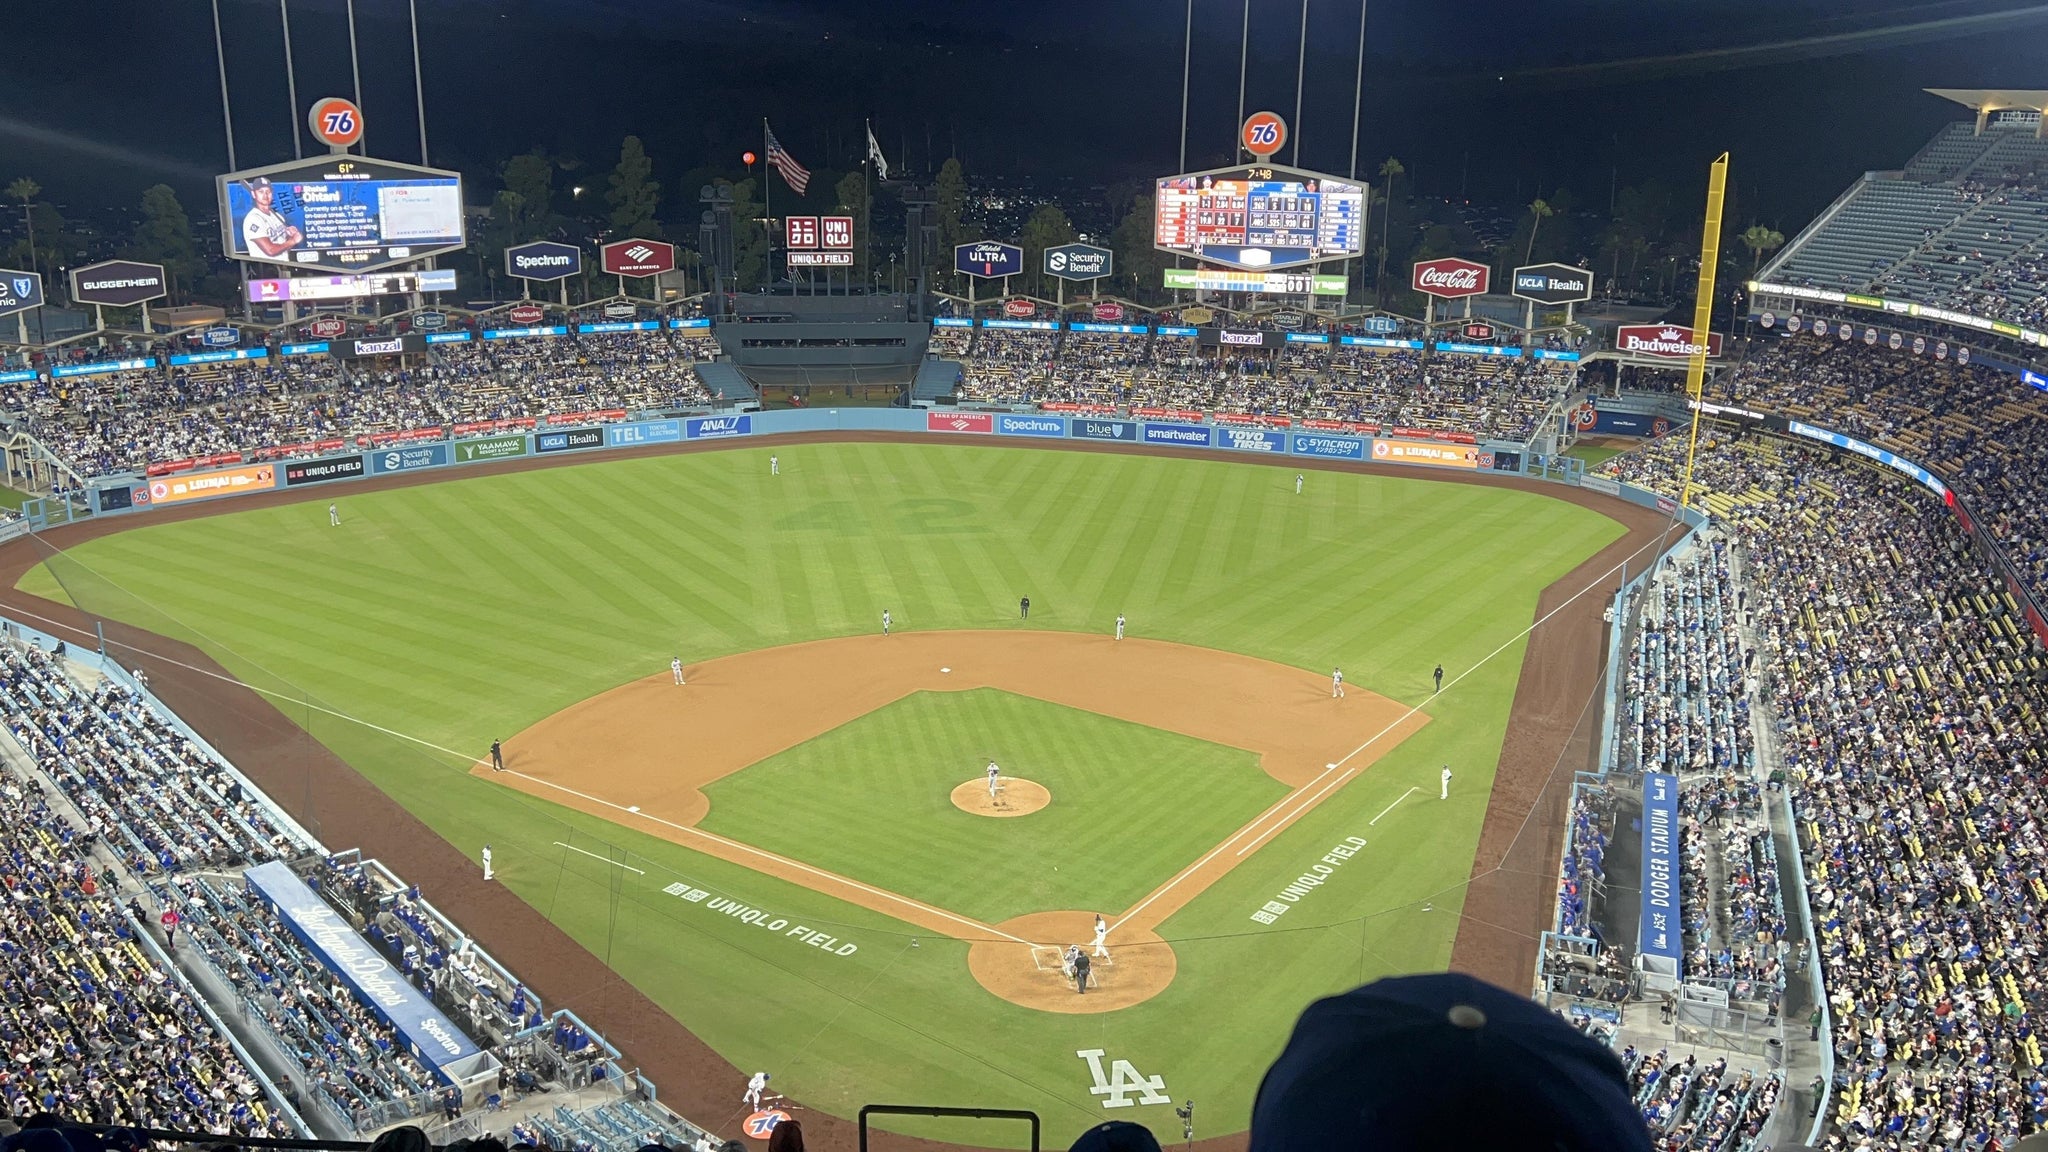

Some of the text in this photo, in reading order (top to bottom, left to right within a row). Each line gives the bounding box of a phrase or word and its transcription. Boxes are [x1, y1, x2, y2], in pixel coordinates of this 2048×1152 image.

[324, 110, 354, 134] 76
[1250, 122, 1277, 144] 76
[339, 164, 354, 173] 61°
[1248, 169, 1272, 179] 7:48
[303, 191, 340, 202] Ohtani
[826, 222, 847, 232] UNI
[827, 234, 848, 245] QLO
[516, 255, 569, 269] Spectrum
[792, 254, 850, 264] UNIQLO FIELD
[970, 252, 1007, 262] ULTRA
[1070, 253, 1105, 264] Security
[1070, 262, 1100, 272] Benefit
[1419, 267, 1481, 289] Coca-Cola
[83, 278, 158, 290] GUGGENHEIM
[1306, 281, 1311, 291] 1
[1519, 278, 1584, 291] UCLA Health
[1759, 283, 1783, 293] VOTED
[1793, 288, 1820, 298] CASINO
[1007, 304, 1033, 314] Churu
[1919, 306, 1941, 318] VOTED
[512, 311, 540, 319] Yakult
[317, 322, 340, 334] JINRO
[1369, 321, 1393, 331] TEL
[700, 420, 725, 431] ANA
[1003, 419, 1056, 432] Spectrum
[1087, 423, 1111, 433] blue
[569, 434, 598, 445] Health
[613, 428, 644, 442] TEL
[1148, 430, 1207, 441] smartwater
[1228, 431, 1264, 440] TOYO
[1234, 440, 1273, 450] TIRES
[1309, 438, 1359, 450] SYNCRON
[402, 449, 433, 459] Security
[1480, 455, 1492, 464] 76
[403, 458, 430, 468] Benefit
[306, 462, 361, 476] UNIQLO FIELD
[135, 491, 147, 502] 76
[1651, 809, 1669, 854] STADIUM
[1276, 836, 1367, 902] UNIQLO FIELD
[1651, 859, 1670, 907] DODGER
[706, 897, 858, 956] UNIQLO FIELD
[352, 958, 408, 1006] Dodgers
[420, 1018, 458, 1053] Spectrum
[1076, 1049, 1171, 1108] LA
